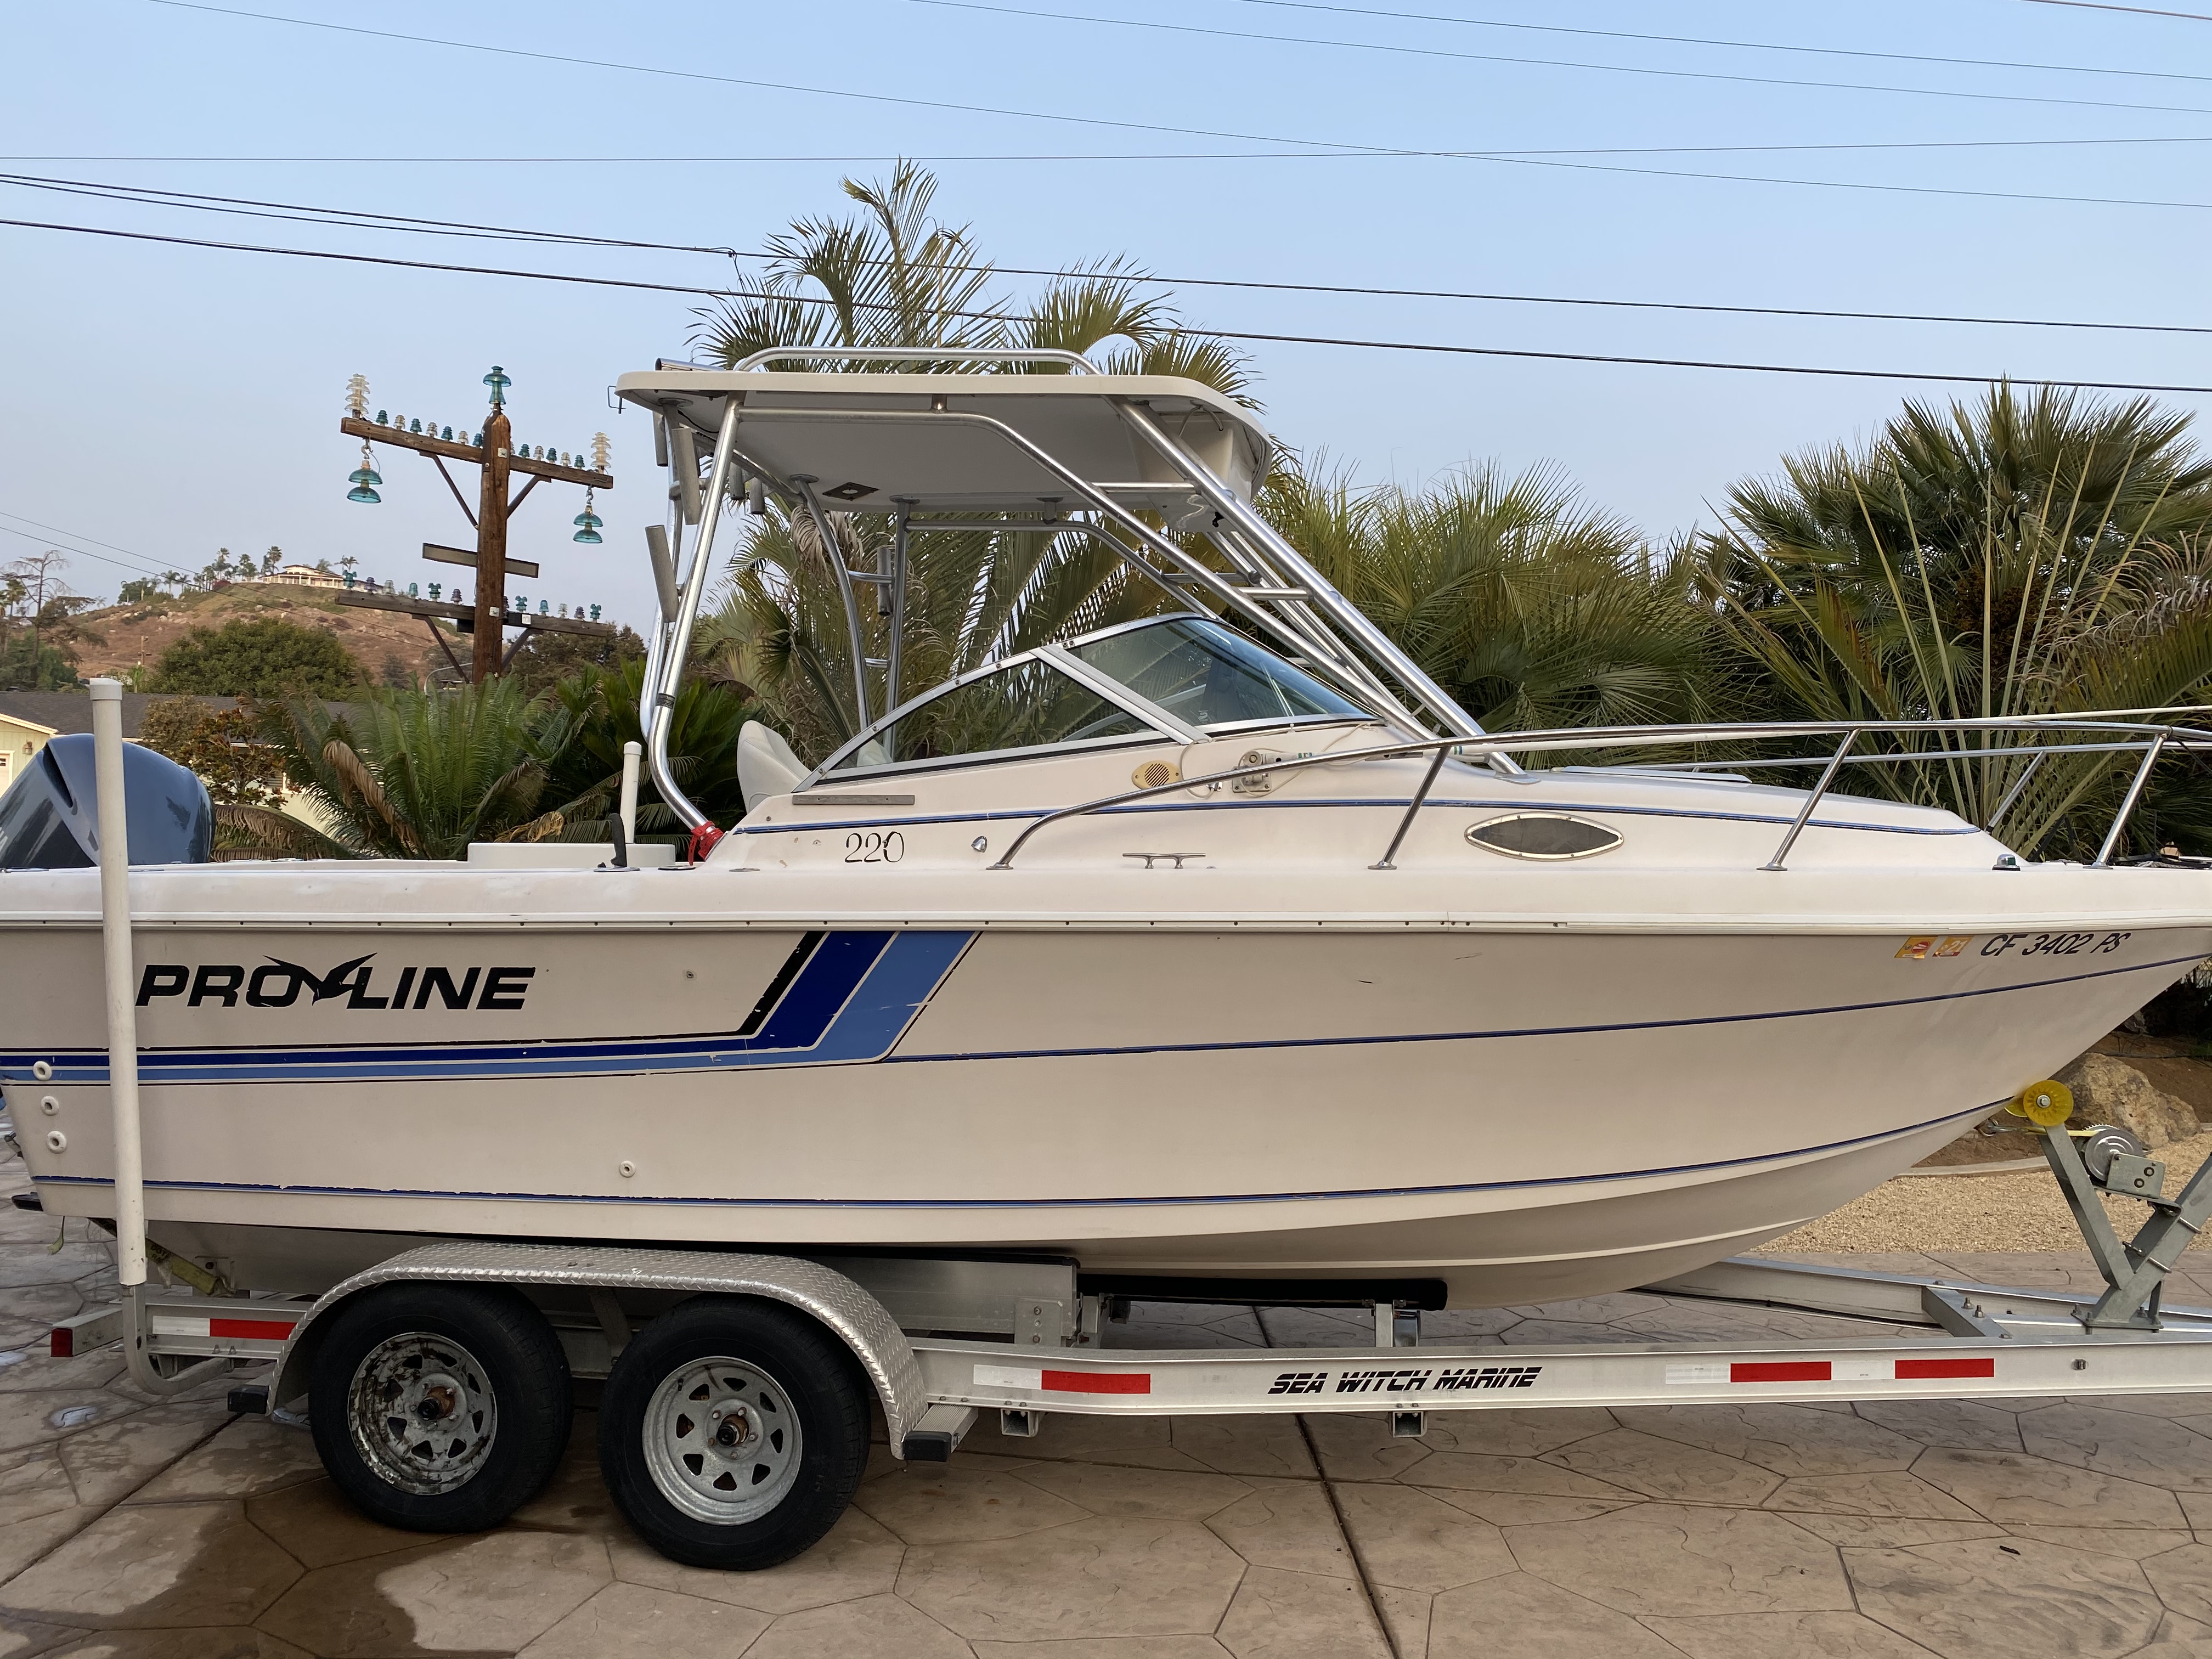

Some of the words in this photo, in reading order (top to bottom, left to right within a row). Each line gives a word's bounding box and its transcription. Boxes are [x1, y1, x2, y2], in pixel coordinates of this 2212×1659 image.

[844, 831, 905, 863] 220
[1944, 940, 1968, 953] 21
[1980, 934, 2028, 957] CF
[2022, 933, 2095, 956] 3402
[2089, 932, 2131, 955] PS
[1267, 1372, 1328, 1395] SEA
[1335, 1369, 1433, 1393] WITCH
[1432, 1366, 1543, 1391] MARINE
